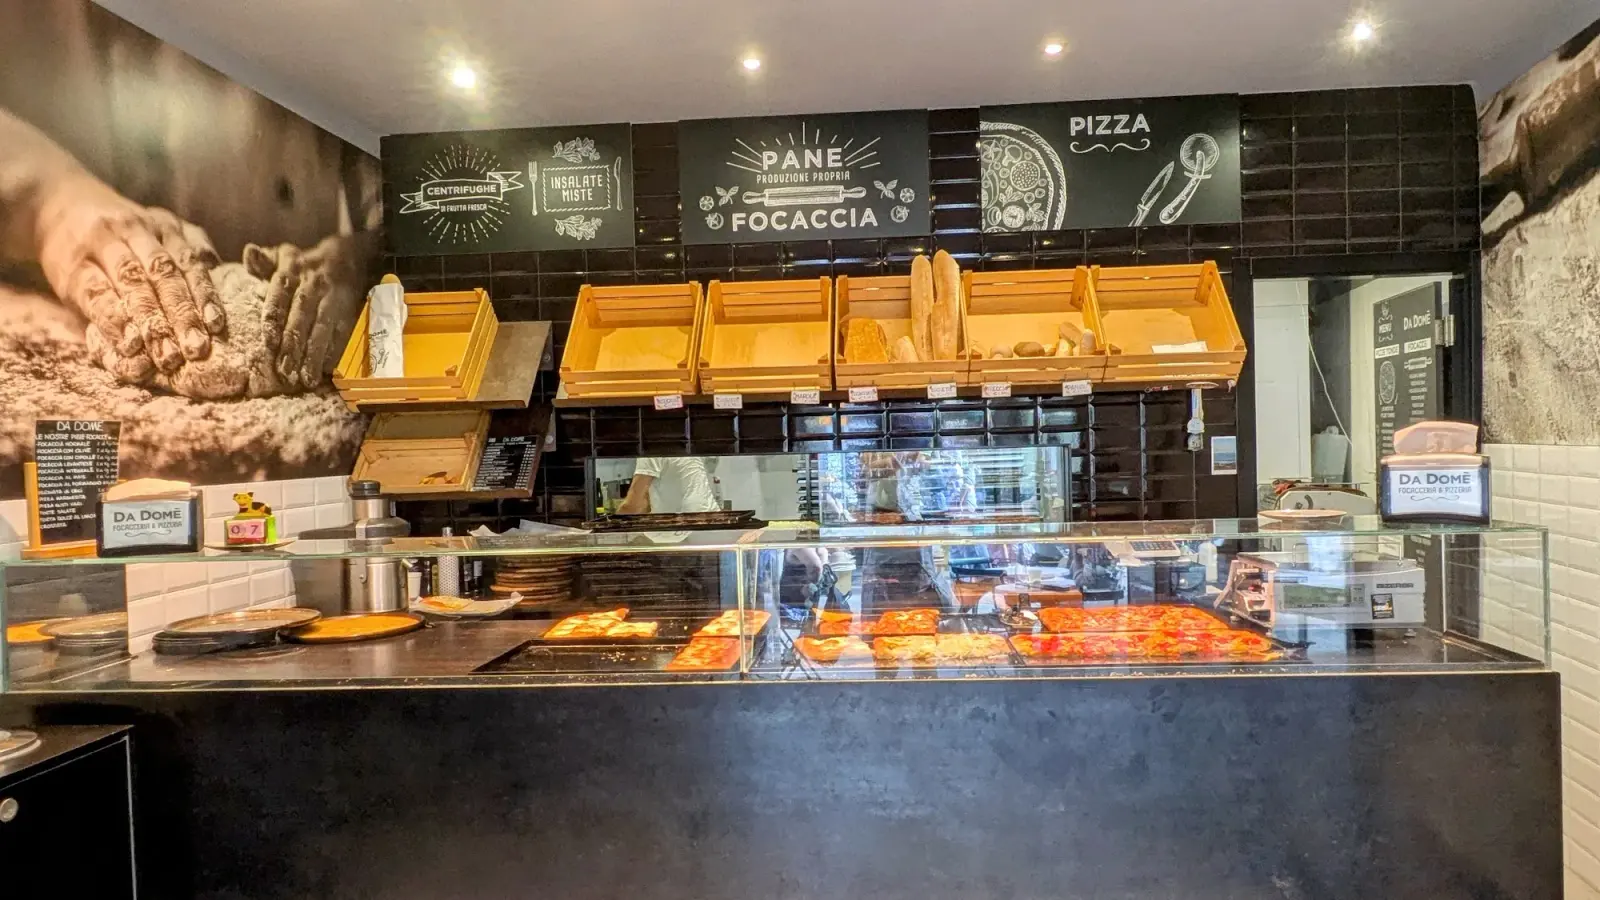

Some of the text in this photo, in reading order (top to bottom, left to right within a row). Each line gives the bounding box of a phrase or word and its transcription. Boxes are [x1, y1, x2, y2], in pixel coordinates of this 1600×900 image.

[1070, 113, 1151, 136] PIZZA
[762, 147, 843, 171] PANE
[551, 174, 603, 189] INSALATE
[756, 170, 850, 184] PRODUZIONE PROPRIA
[427, 184, 497, 195] CENTRIFUGHE
[562, 188, 593, 202] MISTE
[440, 203, 488, 213] DI FRUTTA FRESCA
[732, 207, 879, 232] FOCACCIA
[1403, 317, 1413, 331] DA
[56, 420, 71, 431] DA
[1399, 473, 1422, 485] DA
[1398, 486, 1437, 494] FOCACCERIA
[114, 511, 136, 523] DA
[112, 523, 150, 531] FOCACCERIA
[157, 520, 183, 529] PIZZERIA
